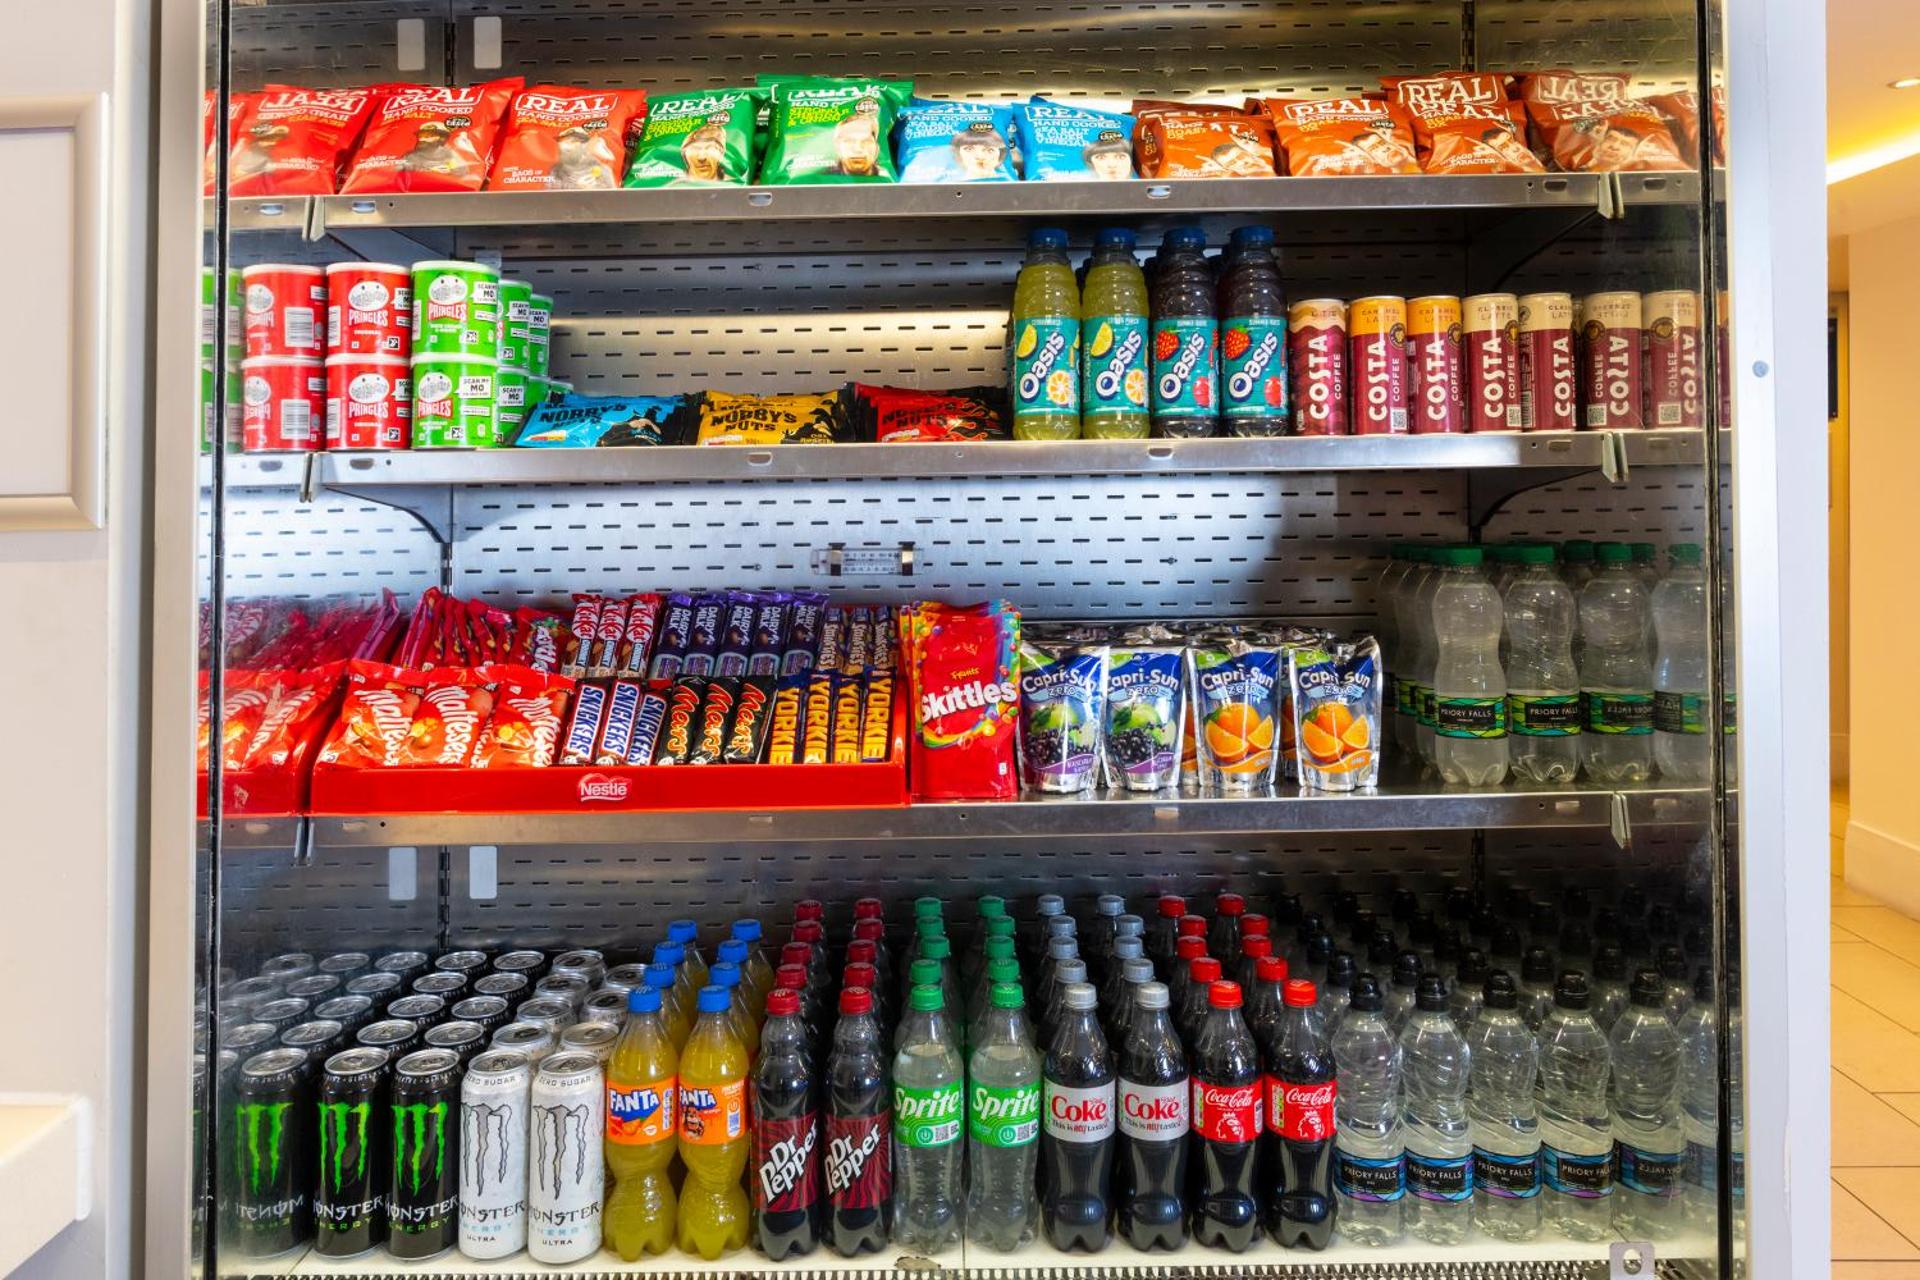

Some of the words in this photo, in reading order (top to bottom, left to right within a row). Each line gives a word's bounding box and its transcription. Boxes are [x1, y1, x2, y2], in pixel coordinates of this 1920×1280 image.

[391, 88, 474, 108] REAL
[1407, 78, 1492, 102] REAL
[523, 97, 610, 113] REAL
[1033, 119, 1070, 129] HAND
[349, 310, 388, 326] PRINGLES
[428, 303, 467, 321] PRINGLES
[1019, 331, 1065, 399] Oasis
[1095, 330, 1142, 396] Oasis
[1160, 333, 1204, 399] Oasis
[1229, 332, 1278, 398] Oasis
[1553, 336, 1571, 416] COSTA
[470, 384, 485, 392] MO
[1308, 335, 1331, 419] COSTA
[1333, 354, 1343, 399] COFFEE
[1367, 340, 1389, 420] COSTA
[1391, 358, 1400, 401] COFFEE
[1426, 339, 1448, 420] COSTA
[1450, 357, 1458, 401] COFFEE
[1483, 337, 1505, 417] COSTA
[1507, 355, 1516, 398] COFFEE
[349, 402, 388, 418] PRINGLES
[418, 400, 452, 418] PRINGLES
[725, 421, 777, 431] NUTS
[575, 606, 597, 639] KitKat
[600, 607, 622, 639] KitKat
[628, 609, 652, 641] KitKat
[669, 608, 681, 632] MILK
[680, 609, 693, 637] DAIRY
[695, 606, 705, 629] MILK
[706, 606, 718, 632] DAIRY
[730, 605, 740, 630] MILK
[740, 607, 753, 635] DAIRY
[758, 606, 769, 629] MILK
[768, 606, 781, 632] DAIRY
[795, 605, 806, 627] MILK
[806, 605, 817, 632] DAIRY
[577, 641, 592, 666] CHUNKY
[630, 643, 644, 671] CHUNKY
[951, 667, 980, 681] Fruits
[1022, 667, 1098, 692] Capri-Sun
[1201, 667, 1274, 692] Capri-Sun
[1300, 669, 1371, 692] Capri-Sun
[922, 681, 1017, 722] Skittles
[1049, 686, 1076, 697] zero
[1127, 685, 1158, 697] zero
[1226, 685, 1258, 695] zero
[569, 687, 605, 758] SNICKERS
[603, 683, 638, 755] SNICKERS
[667, 684, 700, 755] Mars
[702, 683, 734, 757] Mars
[732, 683, 767, 758] Mars
[804, 682, 830, 764] YORKIE
[834, 684, 860, 764] YORKIE
[862, 678, 892, 760] YORKIE
[1440, 707, 1466, 718] PRIORY
[1468, 709, 1493, 719] FALLS
[1529, 707, 1559, 716] PRIORY
[628, 696, 666, 766] SNICKERS
[770, 688, 800, 764] YORKIE
[484, 1076, 516, 1087] SUGAR
[561, 1075, 591, 1088] SUGAR
[609, 1089, 660, 1112] FANTA
[894, 1087, 959, 1121] Sprite
[973, 1087, 1039, 1121] Sprite
[1051, 1095, 1107, 1121] Coke
[1124, 1093, 1180, 1121] Coke
[1206, 1087, 1254, 1107] Coca-Cola
[1286, 1085, 1332, 1105] Coca-Cola
[759, 1118, 817, 1203] Pepper
[769, 1135, 797, 1171] Dr
[824, 1123, 880, 1196] Pepper
[830, 1134, 853, 1167] Dr
[1344, 1165, 1372, 1179] PRIORY
[1374, 1170, 1397, 1180] FALLS
[1408, 1165, 1438, 1179] PRIORY
[1439, 1170, 1462, 1180] FALLS
[1478, 1160, 1508, 1175] PRIORY
[1509, 1167, 1532, 1177] FALLS
[1562, 1164, 1594, 1175] PRIORY
[460, 1200, 525, 1222] ONSTER
[466, 1234, 496, 1242] ULTRA
[543, 1238, 573, 1247] ULTRA
